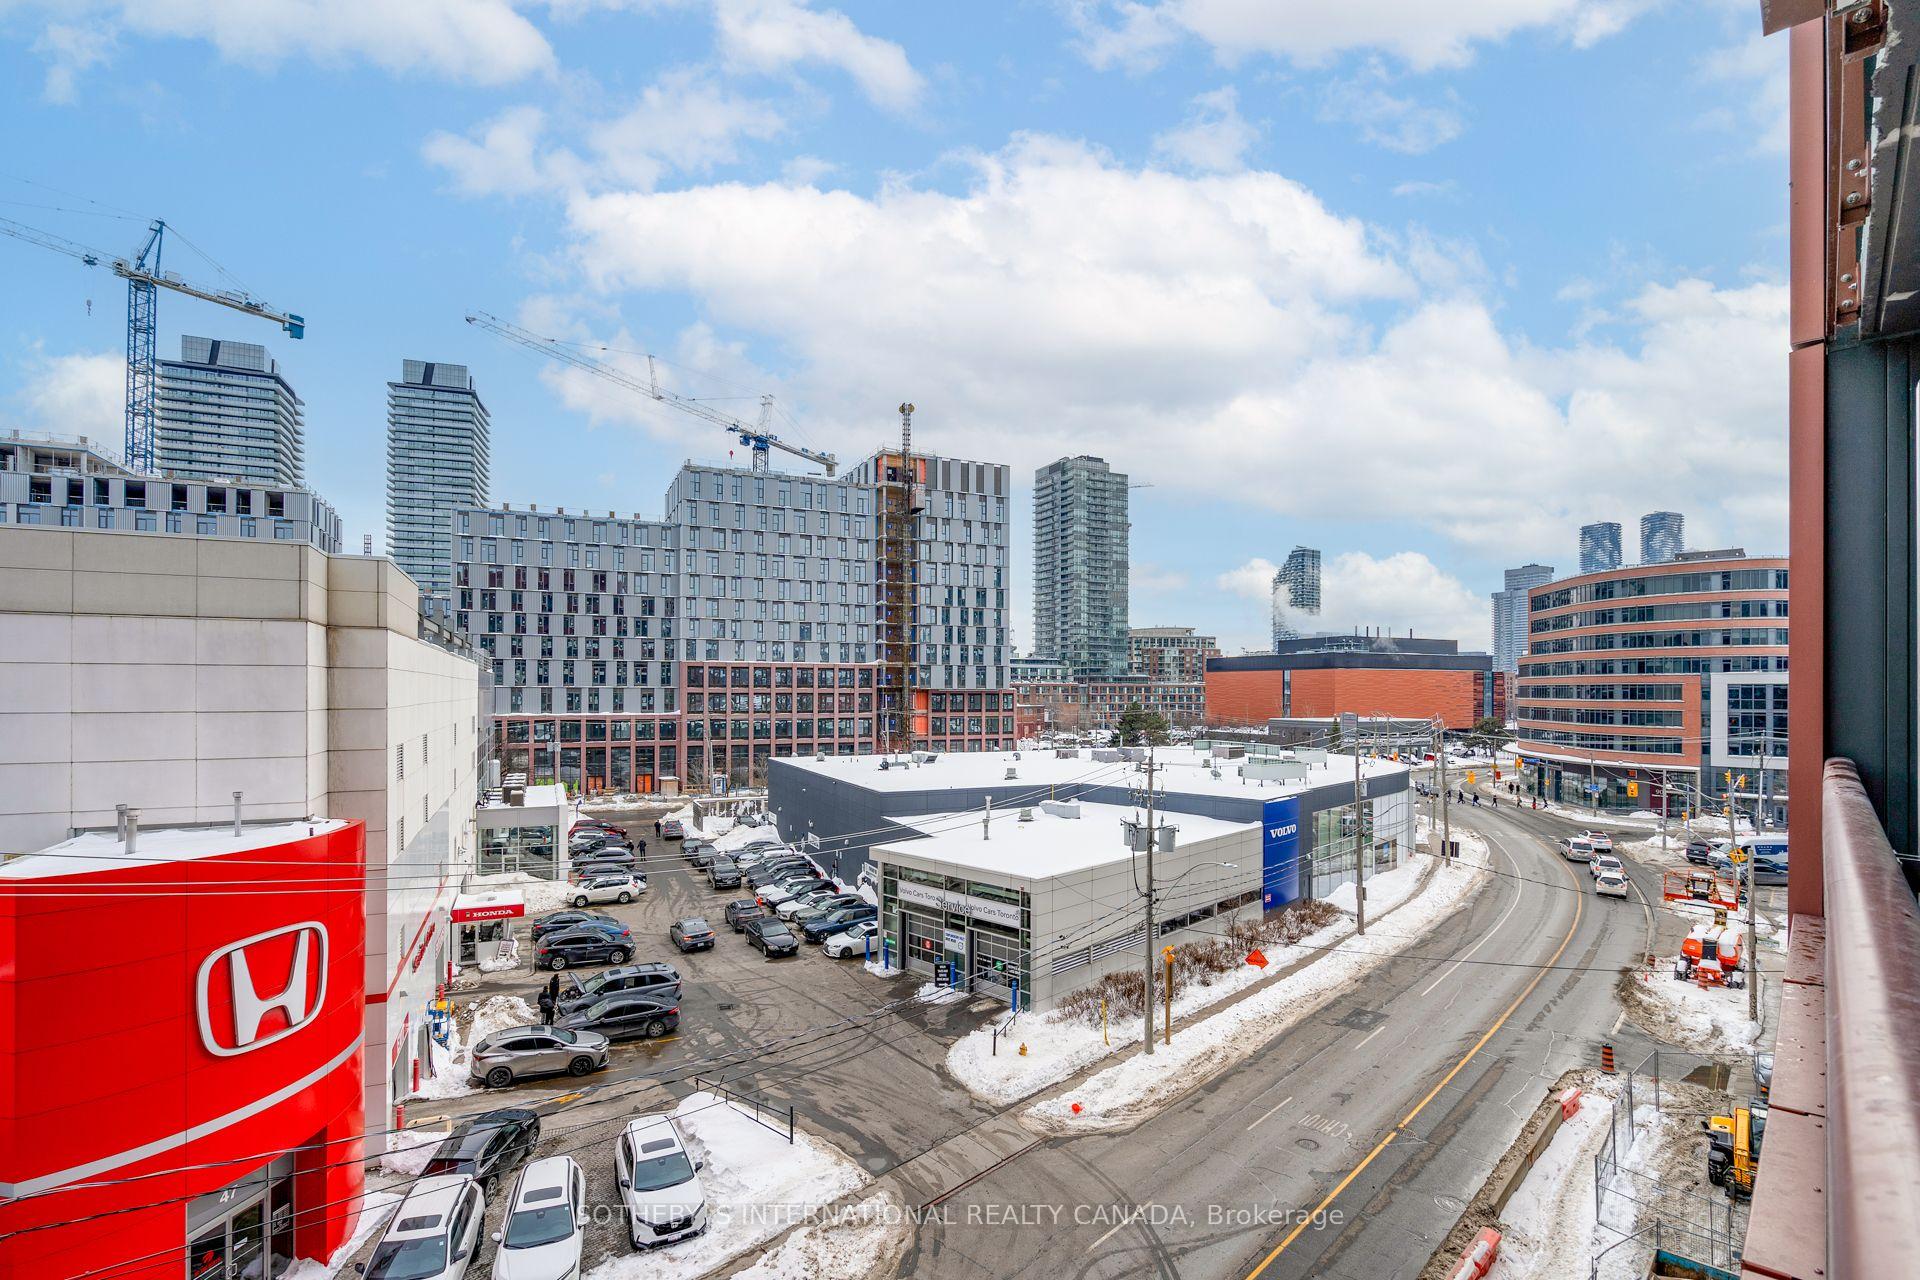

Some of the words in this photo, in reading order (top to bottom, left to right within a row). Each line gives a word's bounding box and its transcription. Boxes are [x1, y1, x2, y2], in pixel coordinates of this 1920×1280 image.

[1270, 824, 1297, 838] VOLVO
[900, 887, 912, 895] Volvo
[912, 890, 924, 898] Cars
[936, 896, 972, 915] Service
[473, 909, 513, 917] HONDA
[983, 907, 996, 916] Cars
[997, 910, 1019, 921] Toronto
